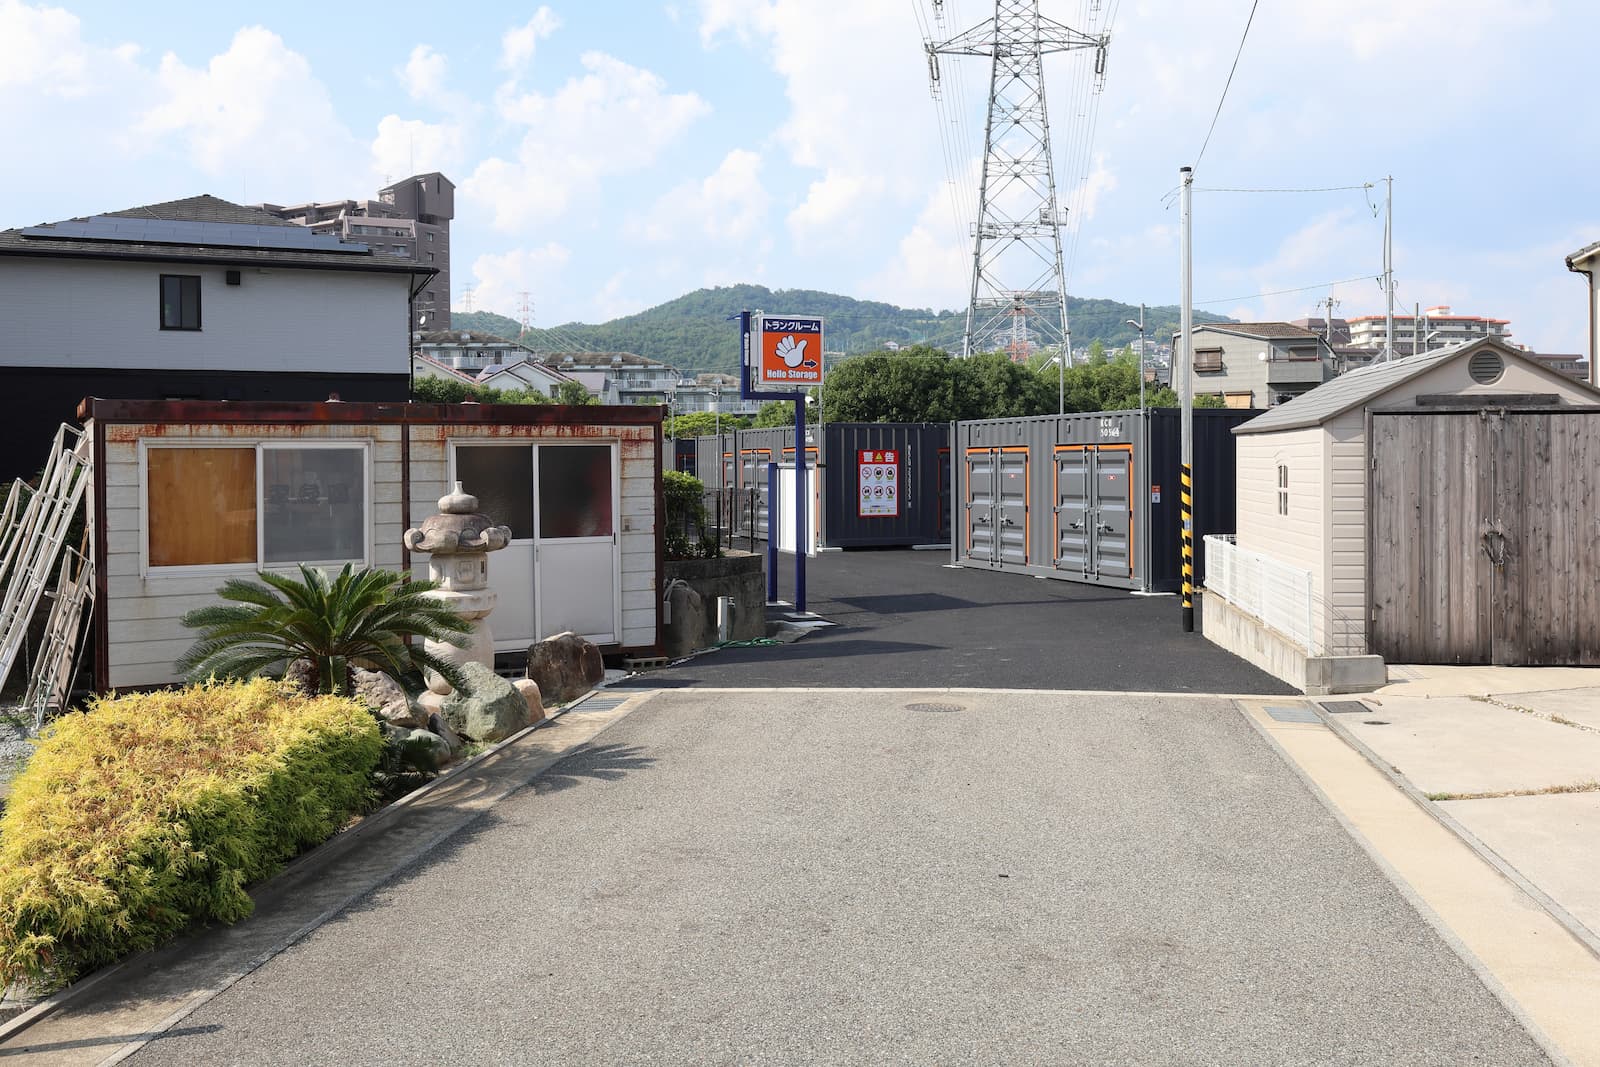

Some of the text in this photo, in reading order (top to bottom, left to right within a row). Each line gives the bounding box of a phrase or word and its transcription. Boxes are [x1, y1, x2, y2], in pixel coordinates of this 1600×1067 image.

[765, 320, 819, 332] トランクルーム
[766, 369, 818, 380] Hello Storage
